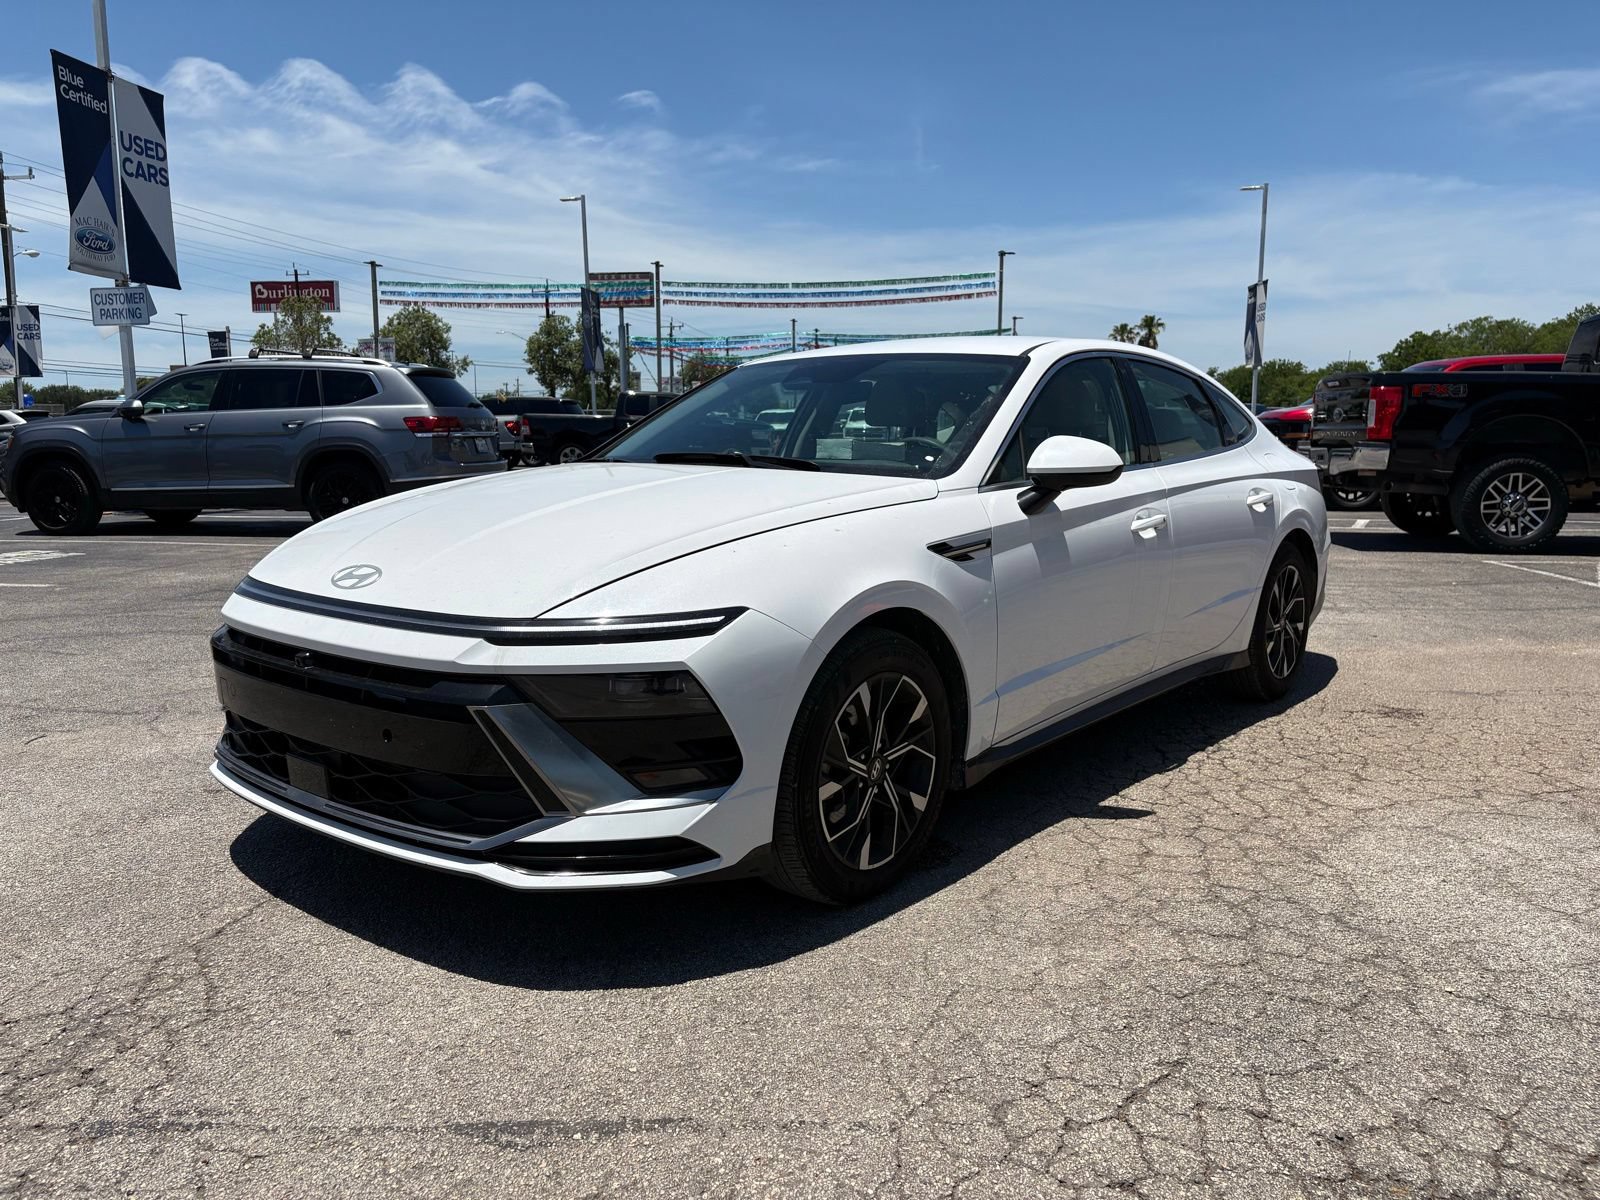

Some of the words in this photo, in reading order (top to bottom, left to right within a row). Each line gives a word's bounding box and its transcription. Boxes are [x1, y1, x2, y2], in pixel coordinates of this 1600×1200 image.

[57, 64, 84, 88] Blue
[60, 84, 108, 114] Certified
[119, 130, 167, 162] USED
[121, 157, 170, 187] CARS
[82, 229, 110, 251] Ford
[94, 292, 145, 306] CUSTOMER
[99, 307, 142, 320] PARKING
[16, 323, 40, 331] USED
[16, 332, 41, 340] CARS
[1412, 384, 1468, 398] FX4
